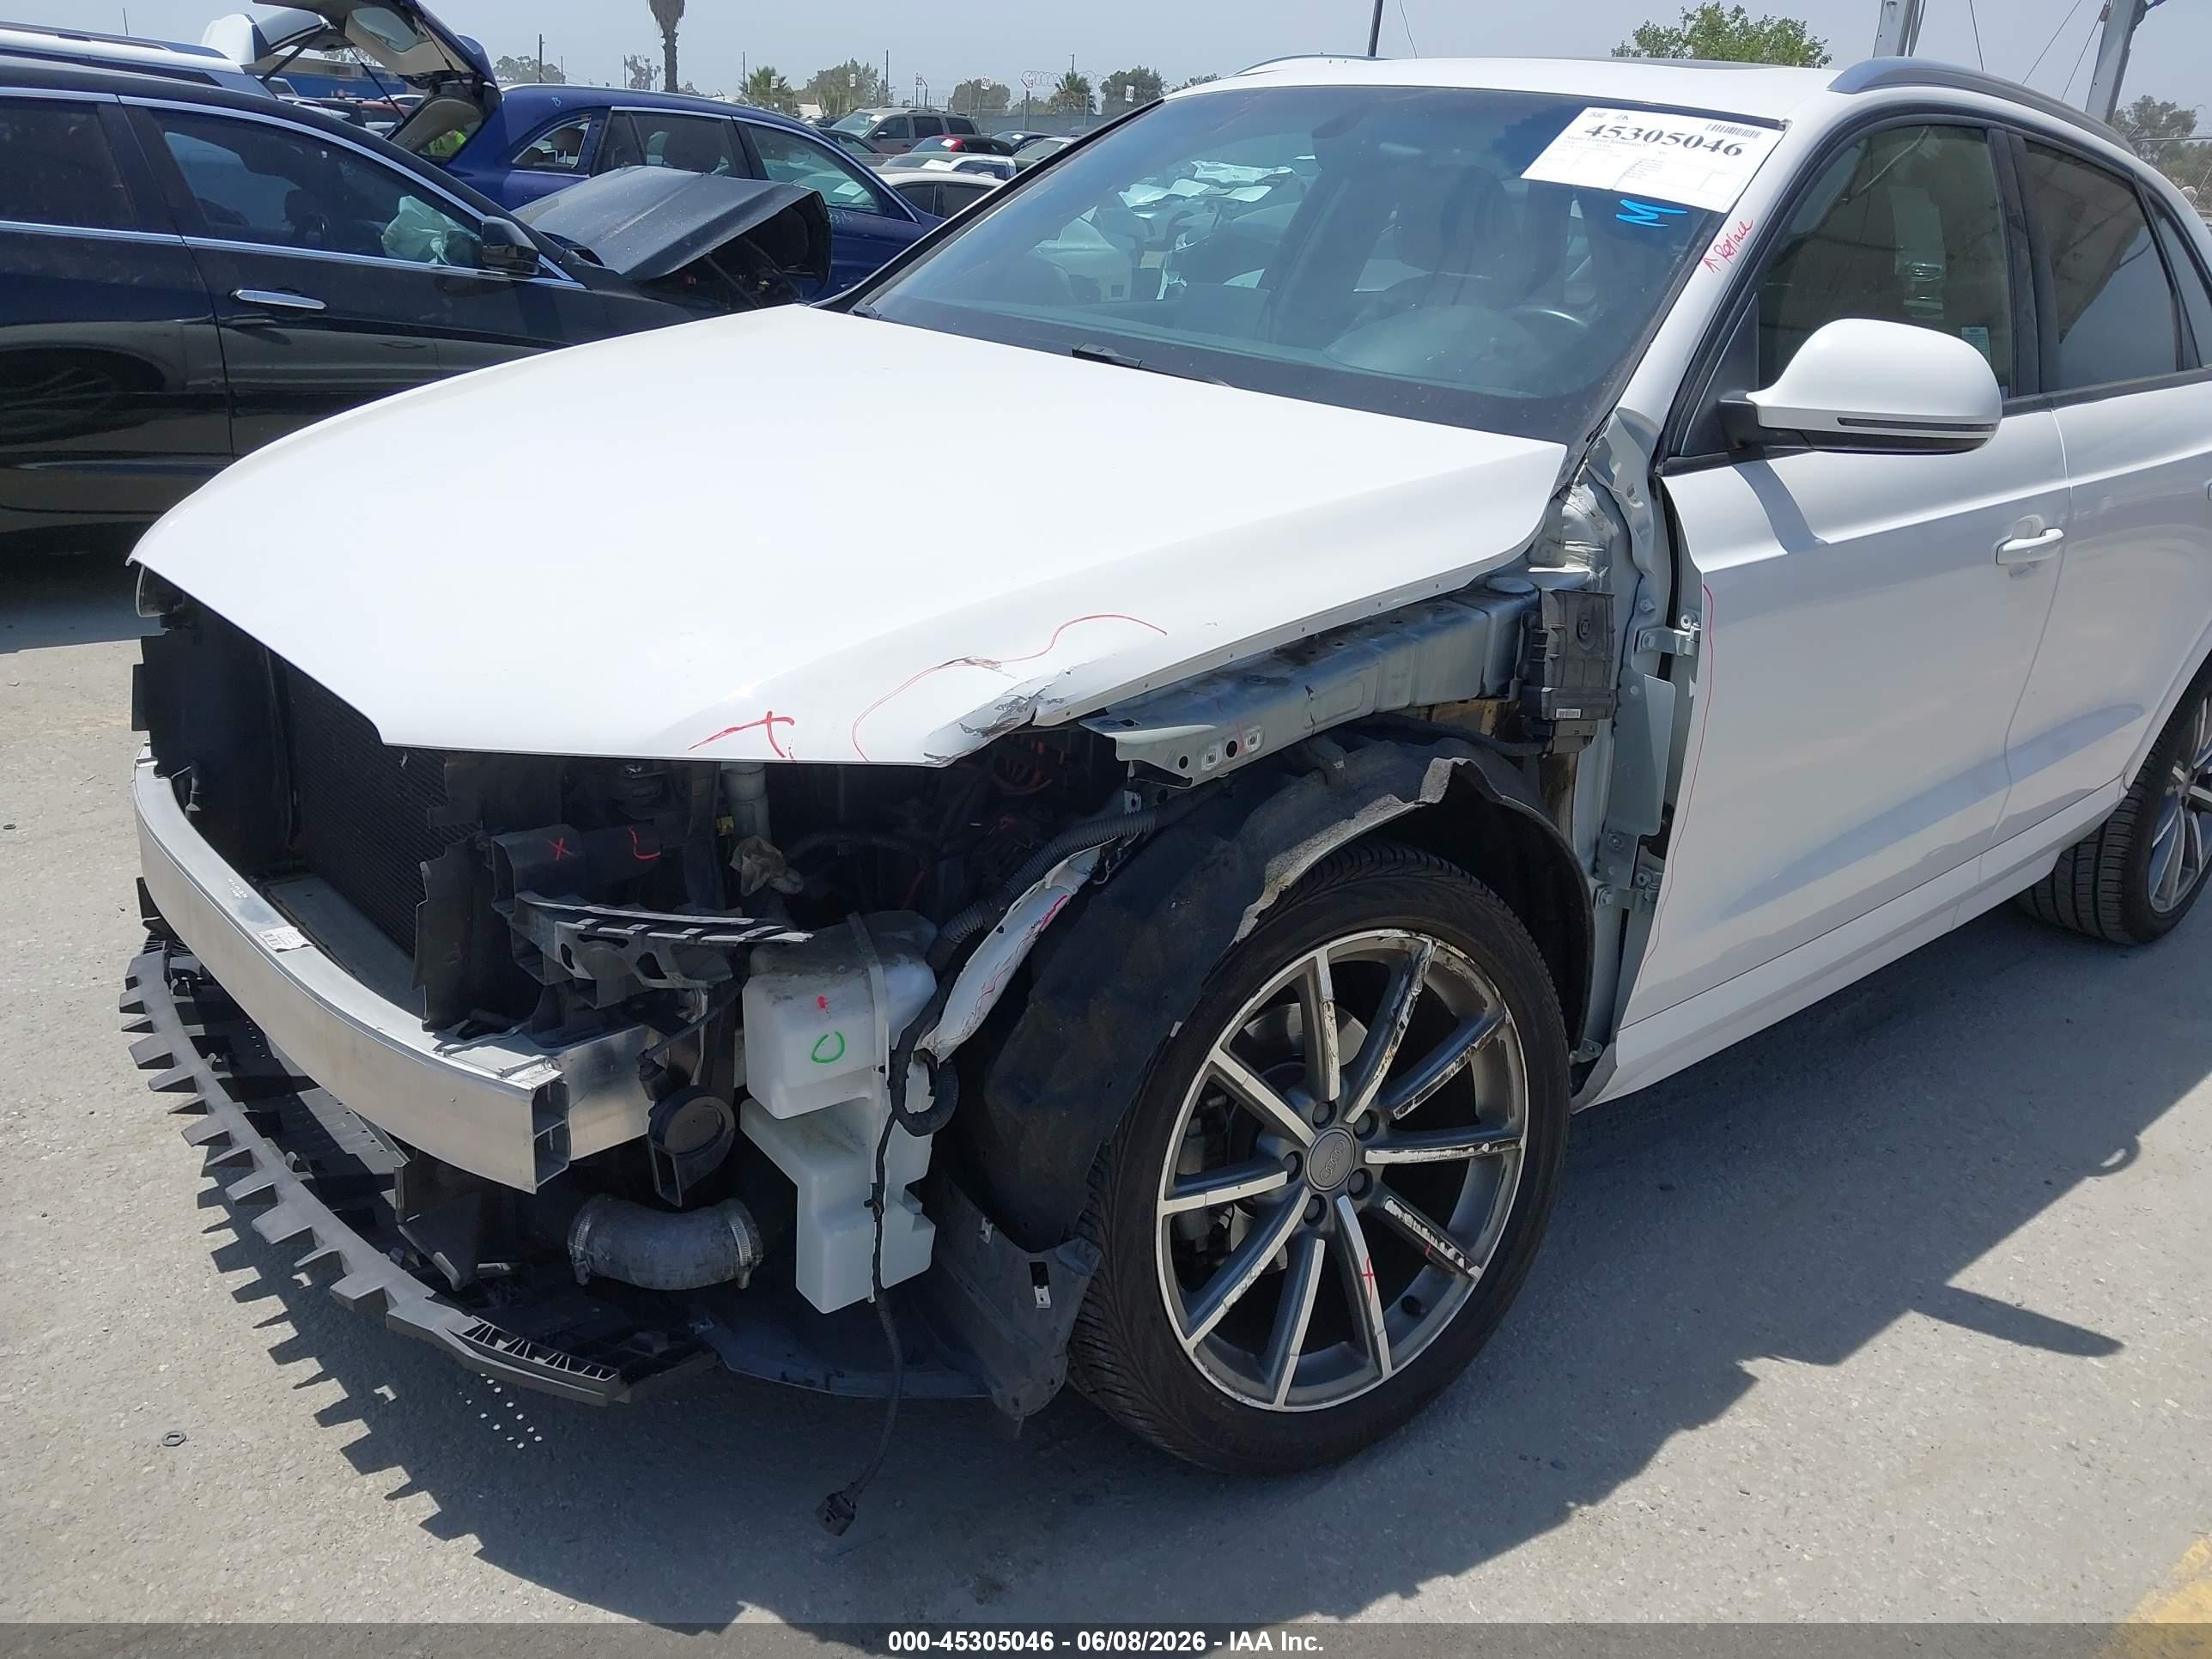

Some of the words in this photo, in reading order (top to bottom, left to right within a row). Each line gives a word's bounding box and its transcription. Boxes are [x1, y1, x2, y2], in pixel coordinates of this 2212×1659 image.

[915, 76, 922, 85] 21
[982, 77, 990, 87] 20
[1126, 88, 1133, 99] 18
[1583, 124, 1748, 156] 45305046
